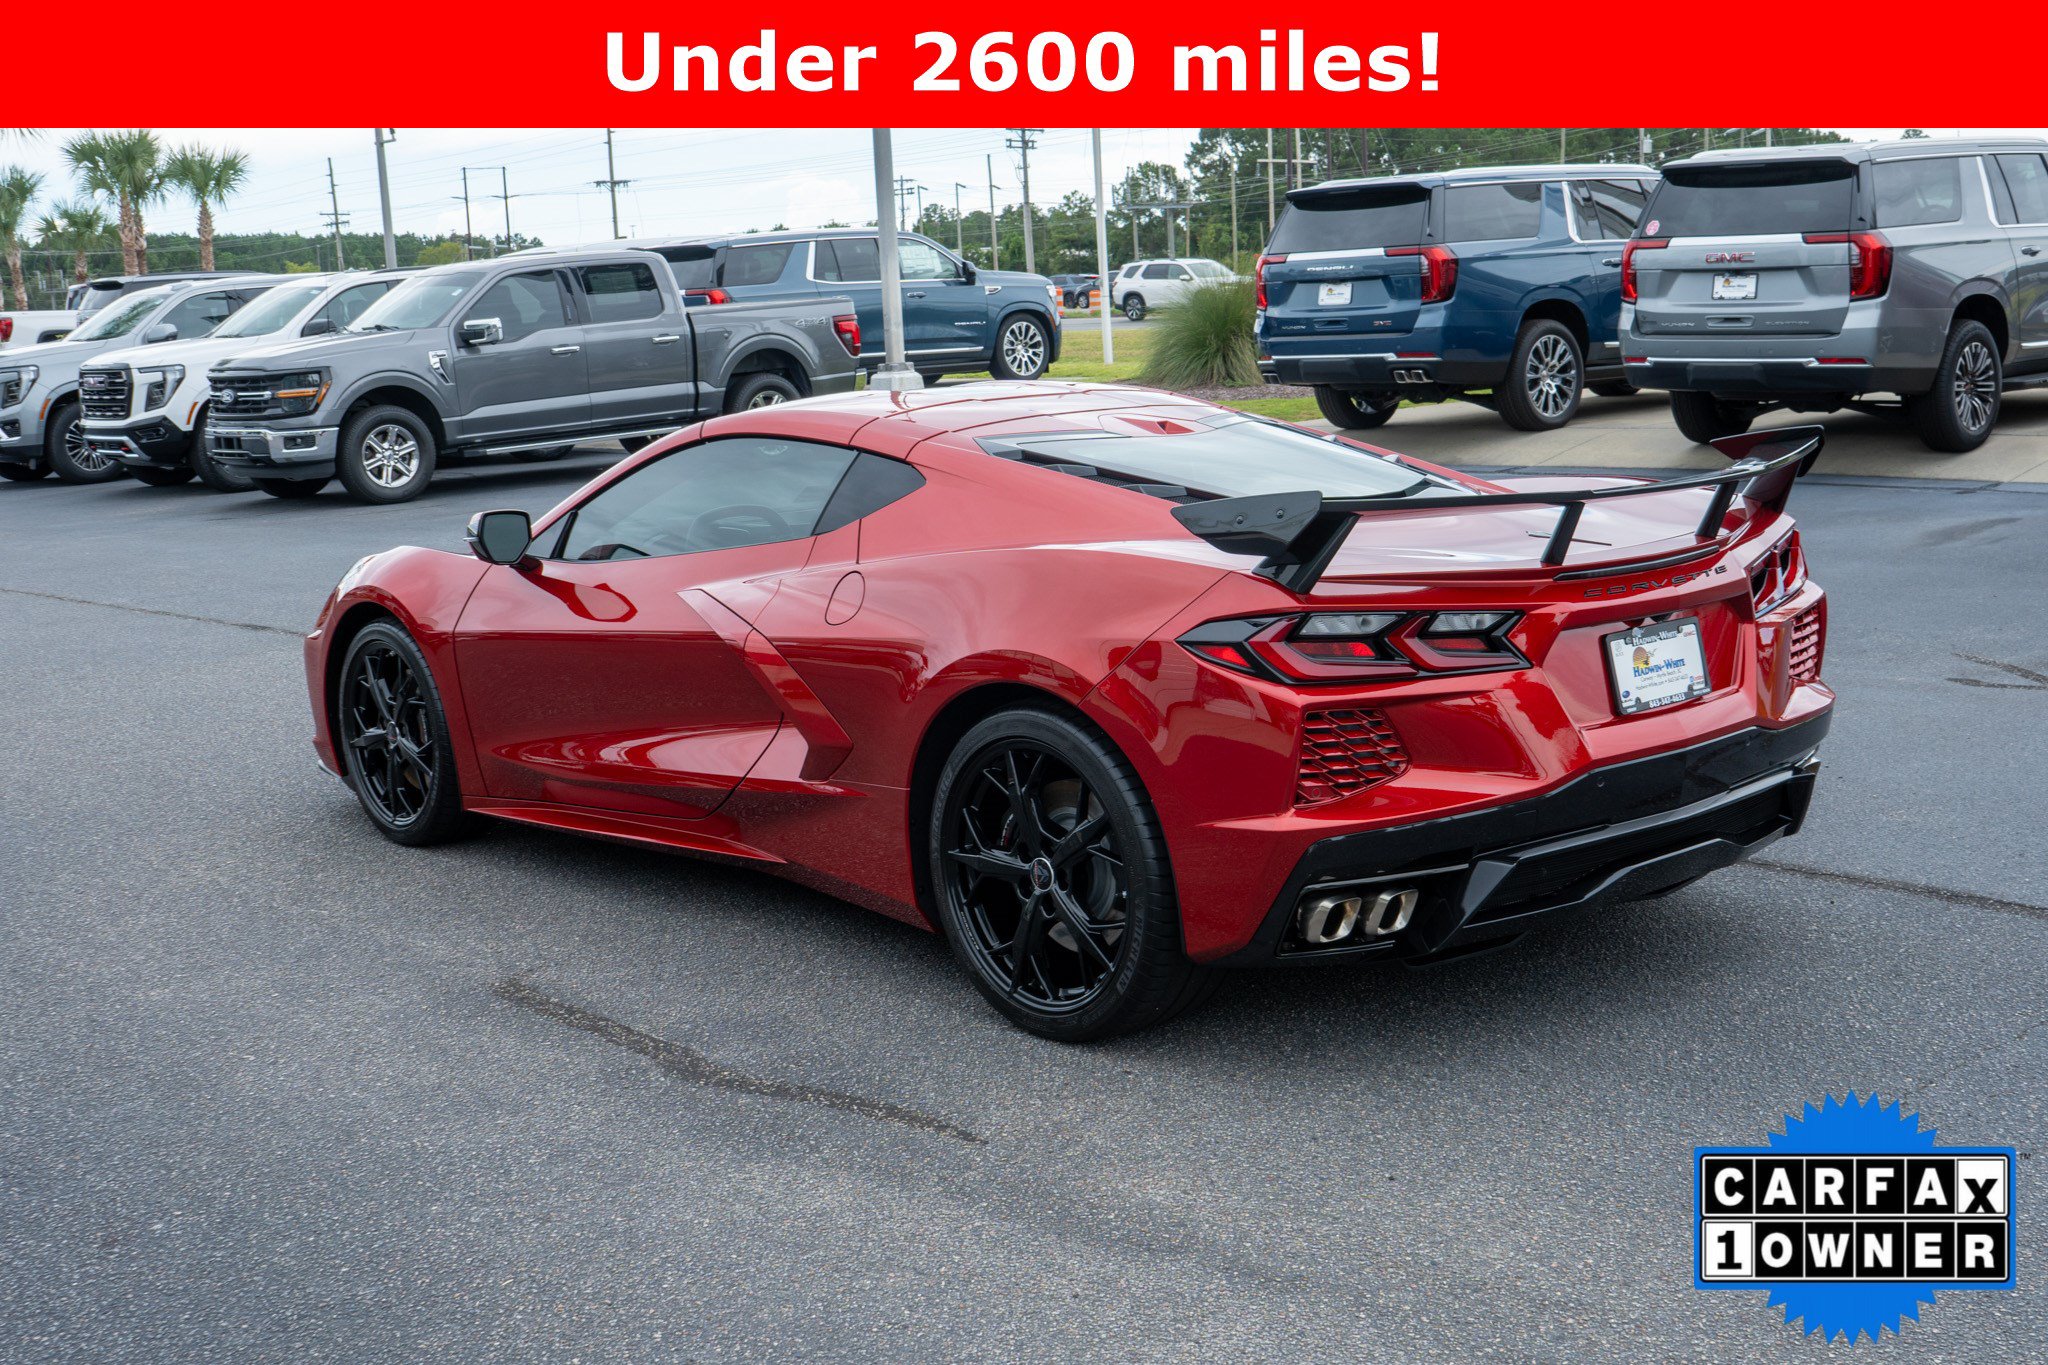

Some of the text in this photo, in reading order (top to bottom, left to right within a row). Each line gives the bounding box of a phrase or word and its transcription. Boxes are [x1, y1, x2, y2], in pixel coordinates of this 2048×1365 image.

[1705, 252, 1756, 264] GMC
[1584, 565, 1728, 598] CORVETTE
[1633, 658, 1685, 677] HADWIN-WHITE
[1119, 915, 1144, 990] MICHELIN
